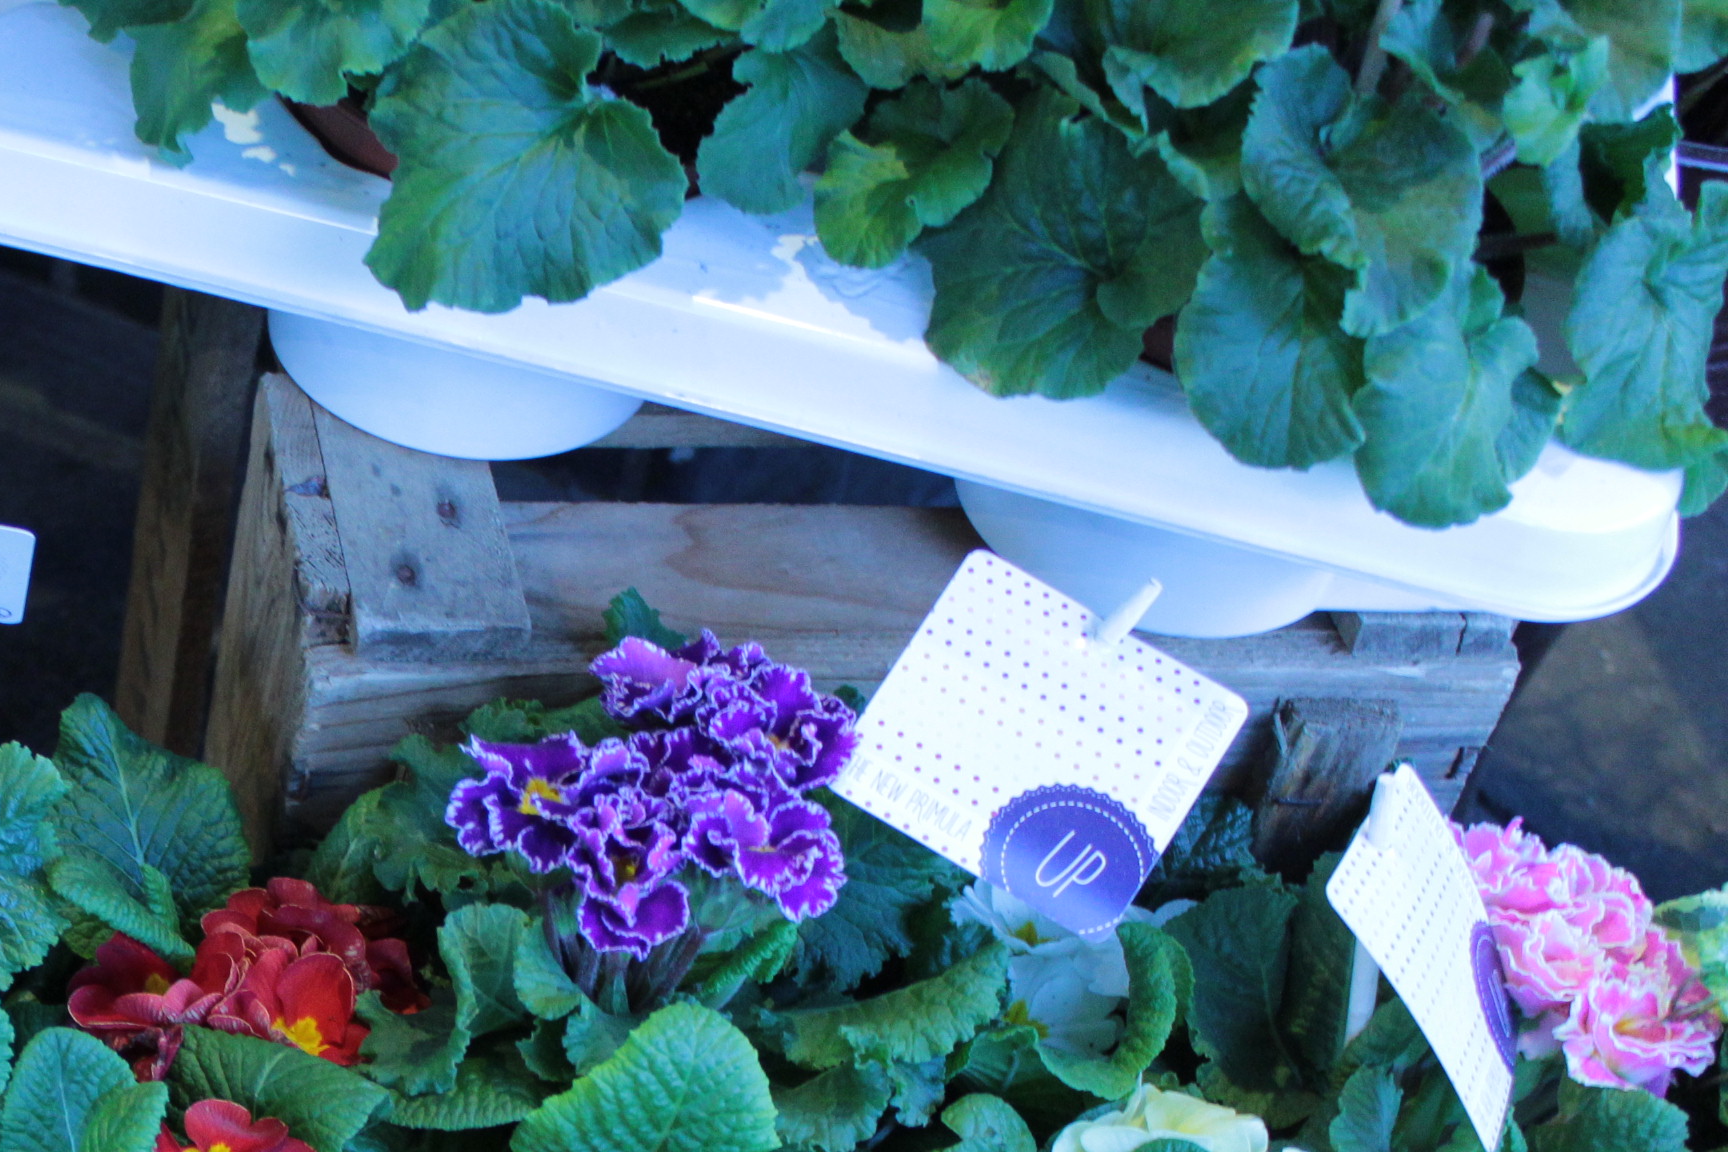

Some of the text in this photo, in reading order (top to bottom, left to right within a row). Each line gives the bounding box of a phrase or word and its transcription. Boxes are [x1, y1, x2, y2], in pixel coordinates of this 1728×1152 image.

[1185, 699, 1232, 759] OUTDOOR
[905, 788, 973, 841] PRIMULA
[1035, 829, 1107, 898] UP
